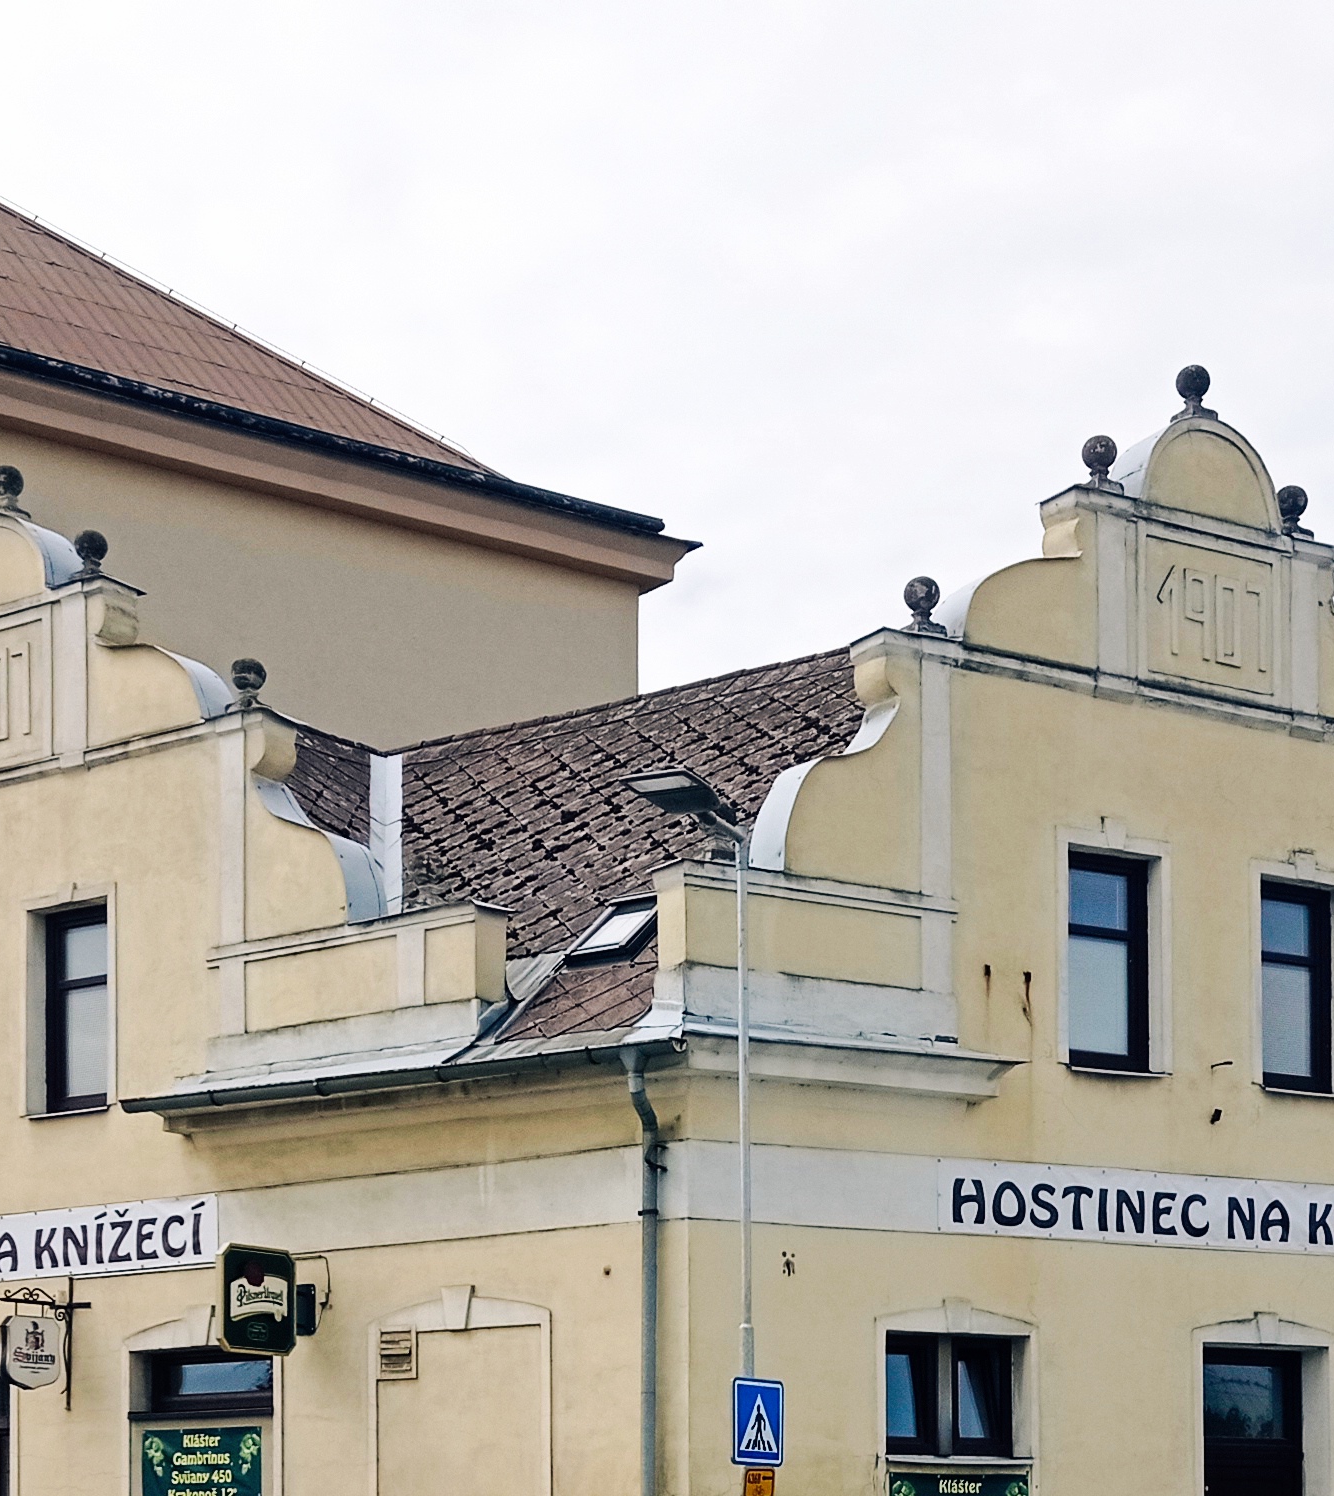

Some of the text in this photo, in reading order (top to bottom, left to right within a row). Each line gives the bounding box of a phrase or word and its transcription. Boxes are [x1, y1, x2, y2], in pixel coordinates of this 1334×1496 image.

[951, 1177, 1210, 1239] HOSTINEC
[1226, 1198, 1291, 1243] NA
[33, 1201, 207, 1270] KNÍŽECÍ
[183, 1434, 221, 1447] Klášter
[173, 1451, 230, 1466] Gambrinus
[211, 1470, 232, 1483] 450
[939, 1479, 982, 1494] Klášter
